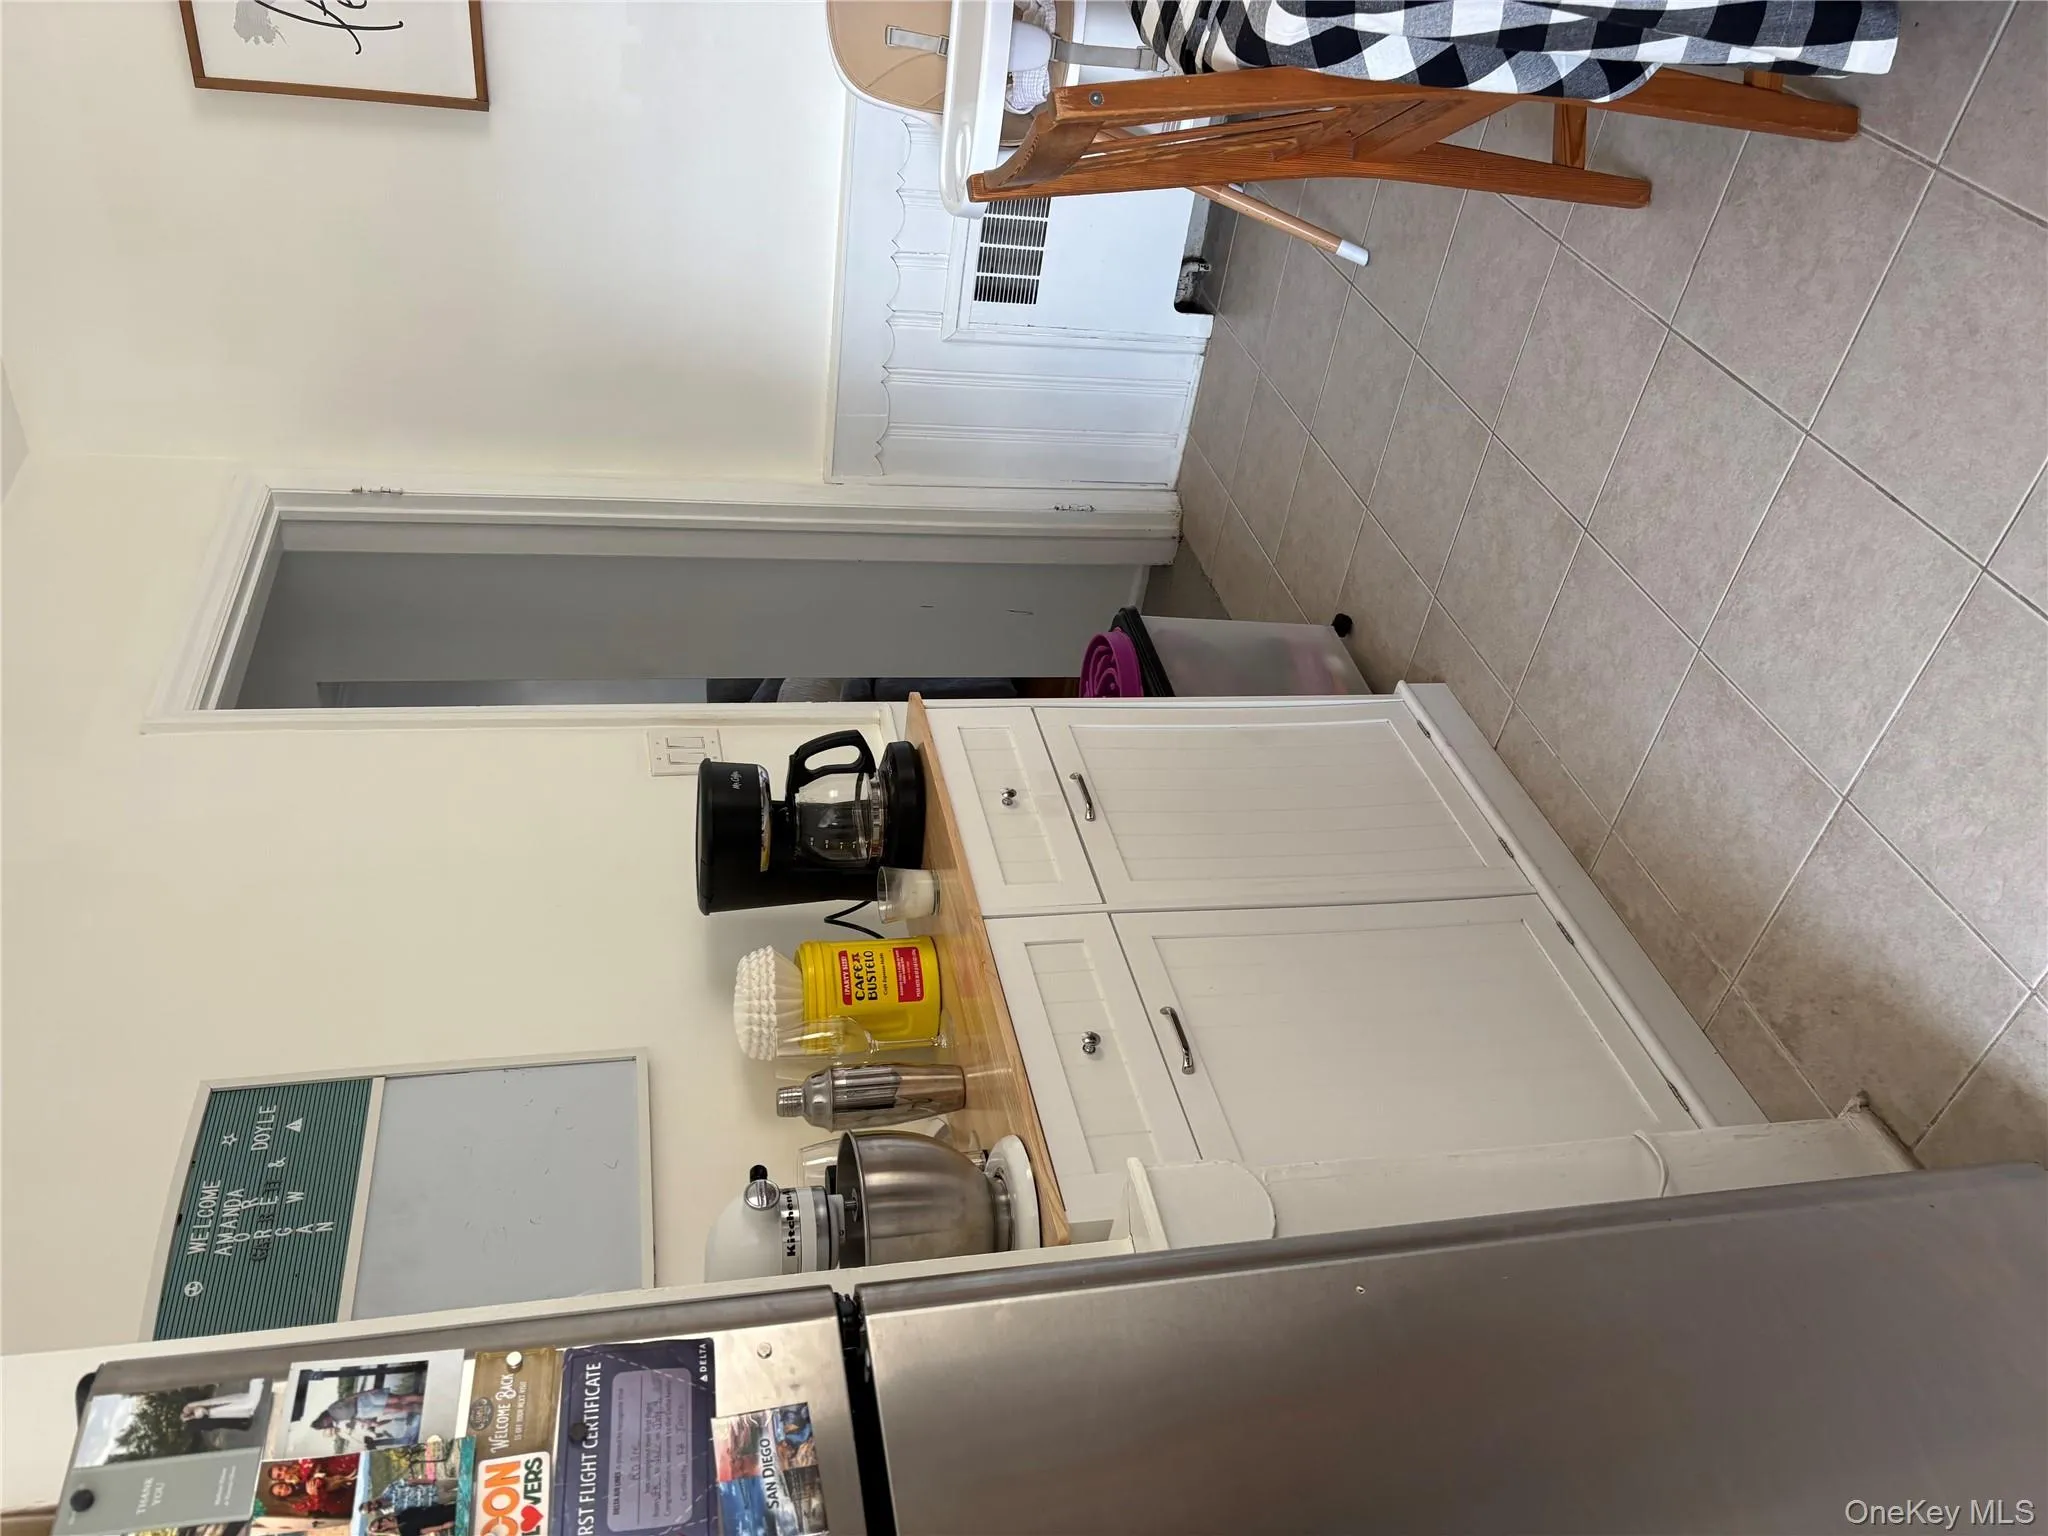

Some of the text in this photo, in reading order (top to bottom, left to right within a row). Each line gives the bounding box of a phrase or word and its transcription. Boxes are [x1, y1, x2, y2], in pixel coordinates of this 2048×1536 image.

[863, 950, 878, 1001] BUSTELO
[250, 1105, 277, 1151] DOYLE
[187, 1180, 221, 1255] WELCOME
[214, 1188, 245, 1256] AMANDA
[700, 1343, 708, 1372] DELTA
[488, 1372, 517, 1454] WELCOME BACK
[582, 1362, 602, 1448] CERTIFICATE
[136, 1477, 154, 1515] THANK
[152, 1482, 166, 1506] YOU
[580, 1453, 598, 1503] FLIGHT
[759, 1438, 780, 1509] SAN DIEGO
